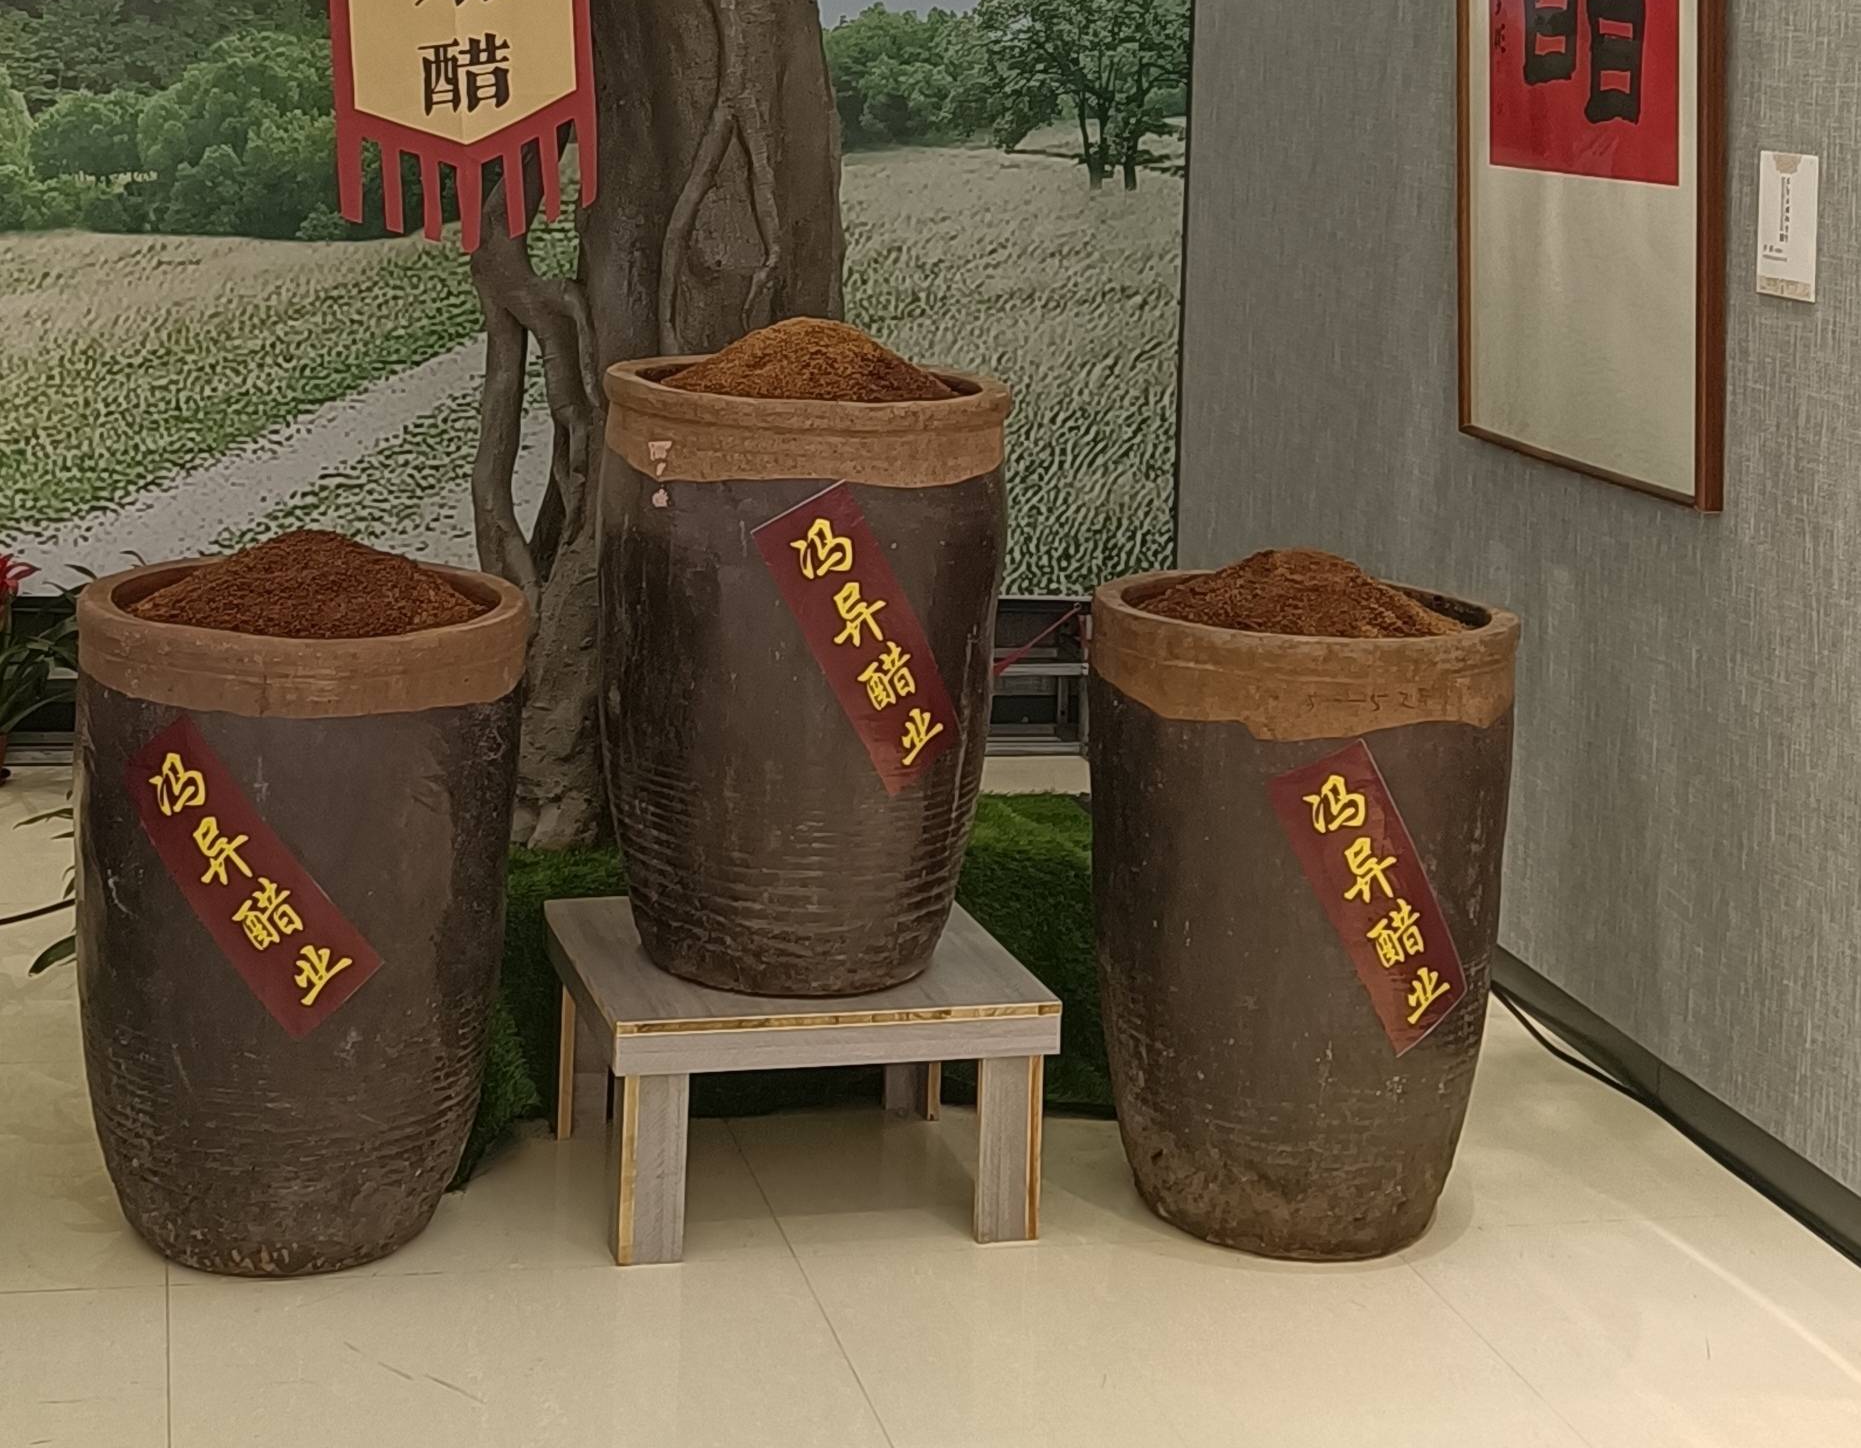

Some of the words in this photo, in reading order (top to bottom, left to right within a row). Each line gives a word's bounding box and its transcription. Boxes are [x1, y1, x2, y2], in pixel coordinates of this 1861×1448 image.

[791, 519, 943, 765] 冯异醋业
[149, 753, 352, 1005] 冯异醋业
[1303, 775, 1450, 1024] 冯异醋业
